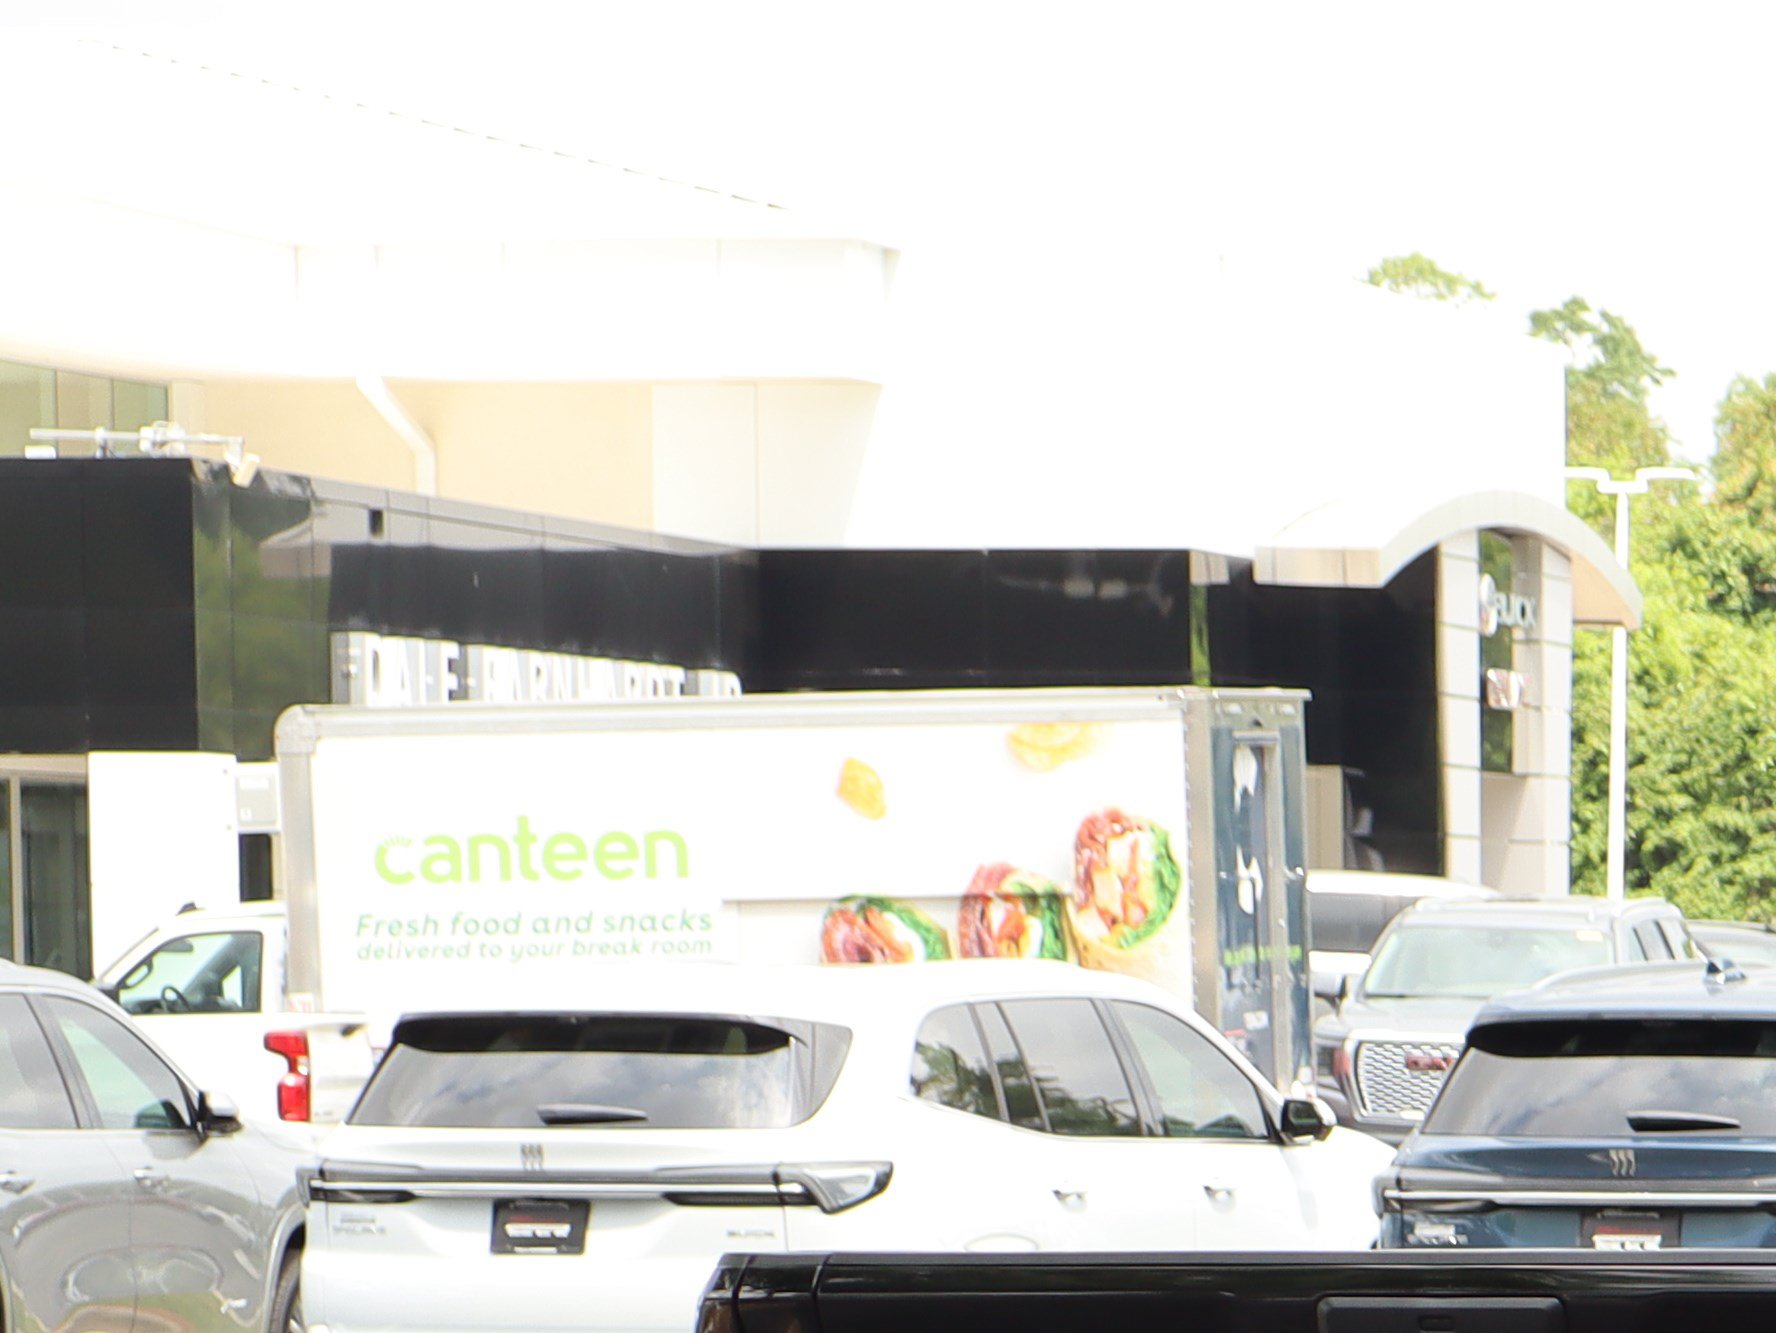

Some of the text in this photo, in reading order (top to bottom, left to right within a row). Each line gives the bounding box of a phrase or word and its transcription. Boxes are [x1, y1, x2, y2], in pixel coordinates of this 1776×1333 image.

[374, 814, 690, 885] canteen
[356, 909, 713, 938] Fresh food and snacks
[356, 938, 713, 965] delivered to your break room
